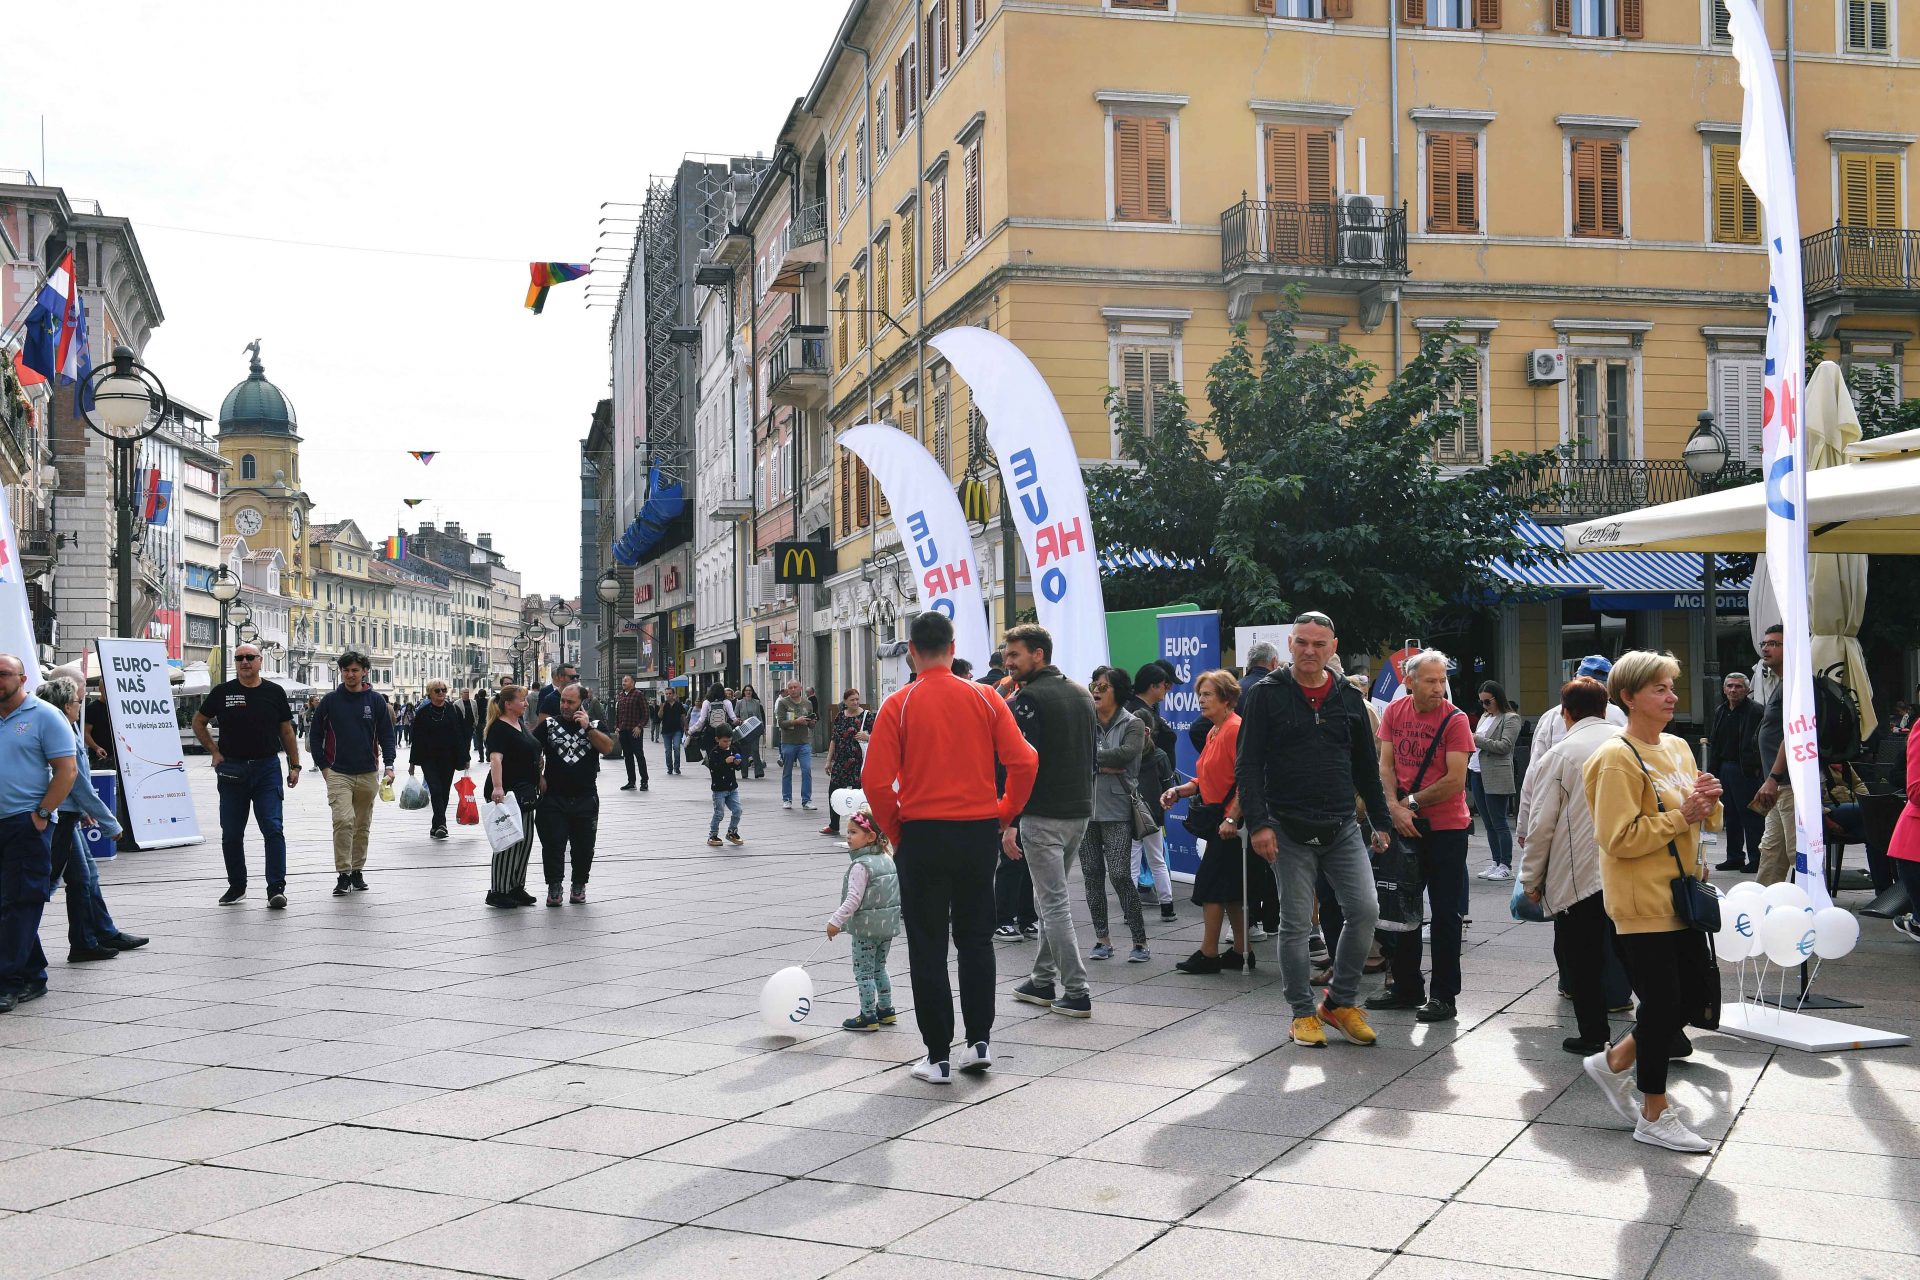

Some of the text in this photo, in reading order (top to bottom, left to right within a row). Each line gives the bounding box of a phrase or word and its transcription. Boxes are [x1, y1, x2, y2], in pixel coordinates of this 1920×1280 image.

[1165, 636, 1208, 657] EURO-
[112, 656, 159, 672] EURO-
[116, 674, 146, 693] NAŠ
[121, 699, 170, 715] NOVAC
[1165, 692, 1201, 712] NOVA
